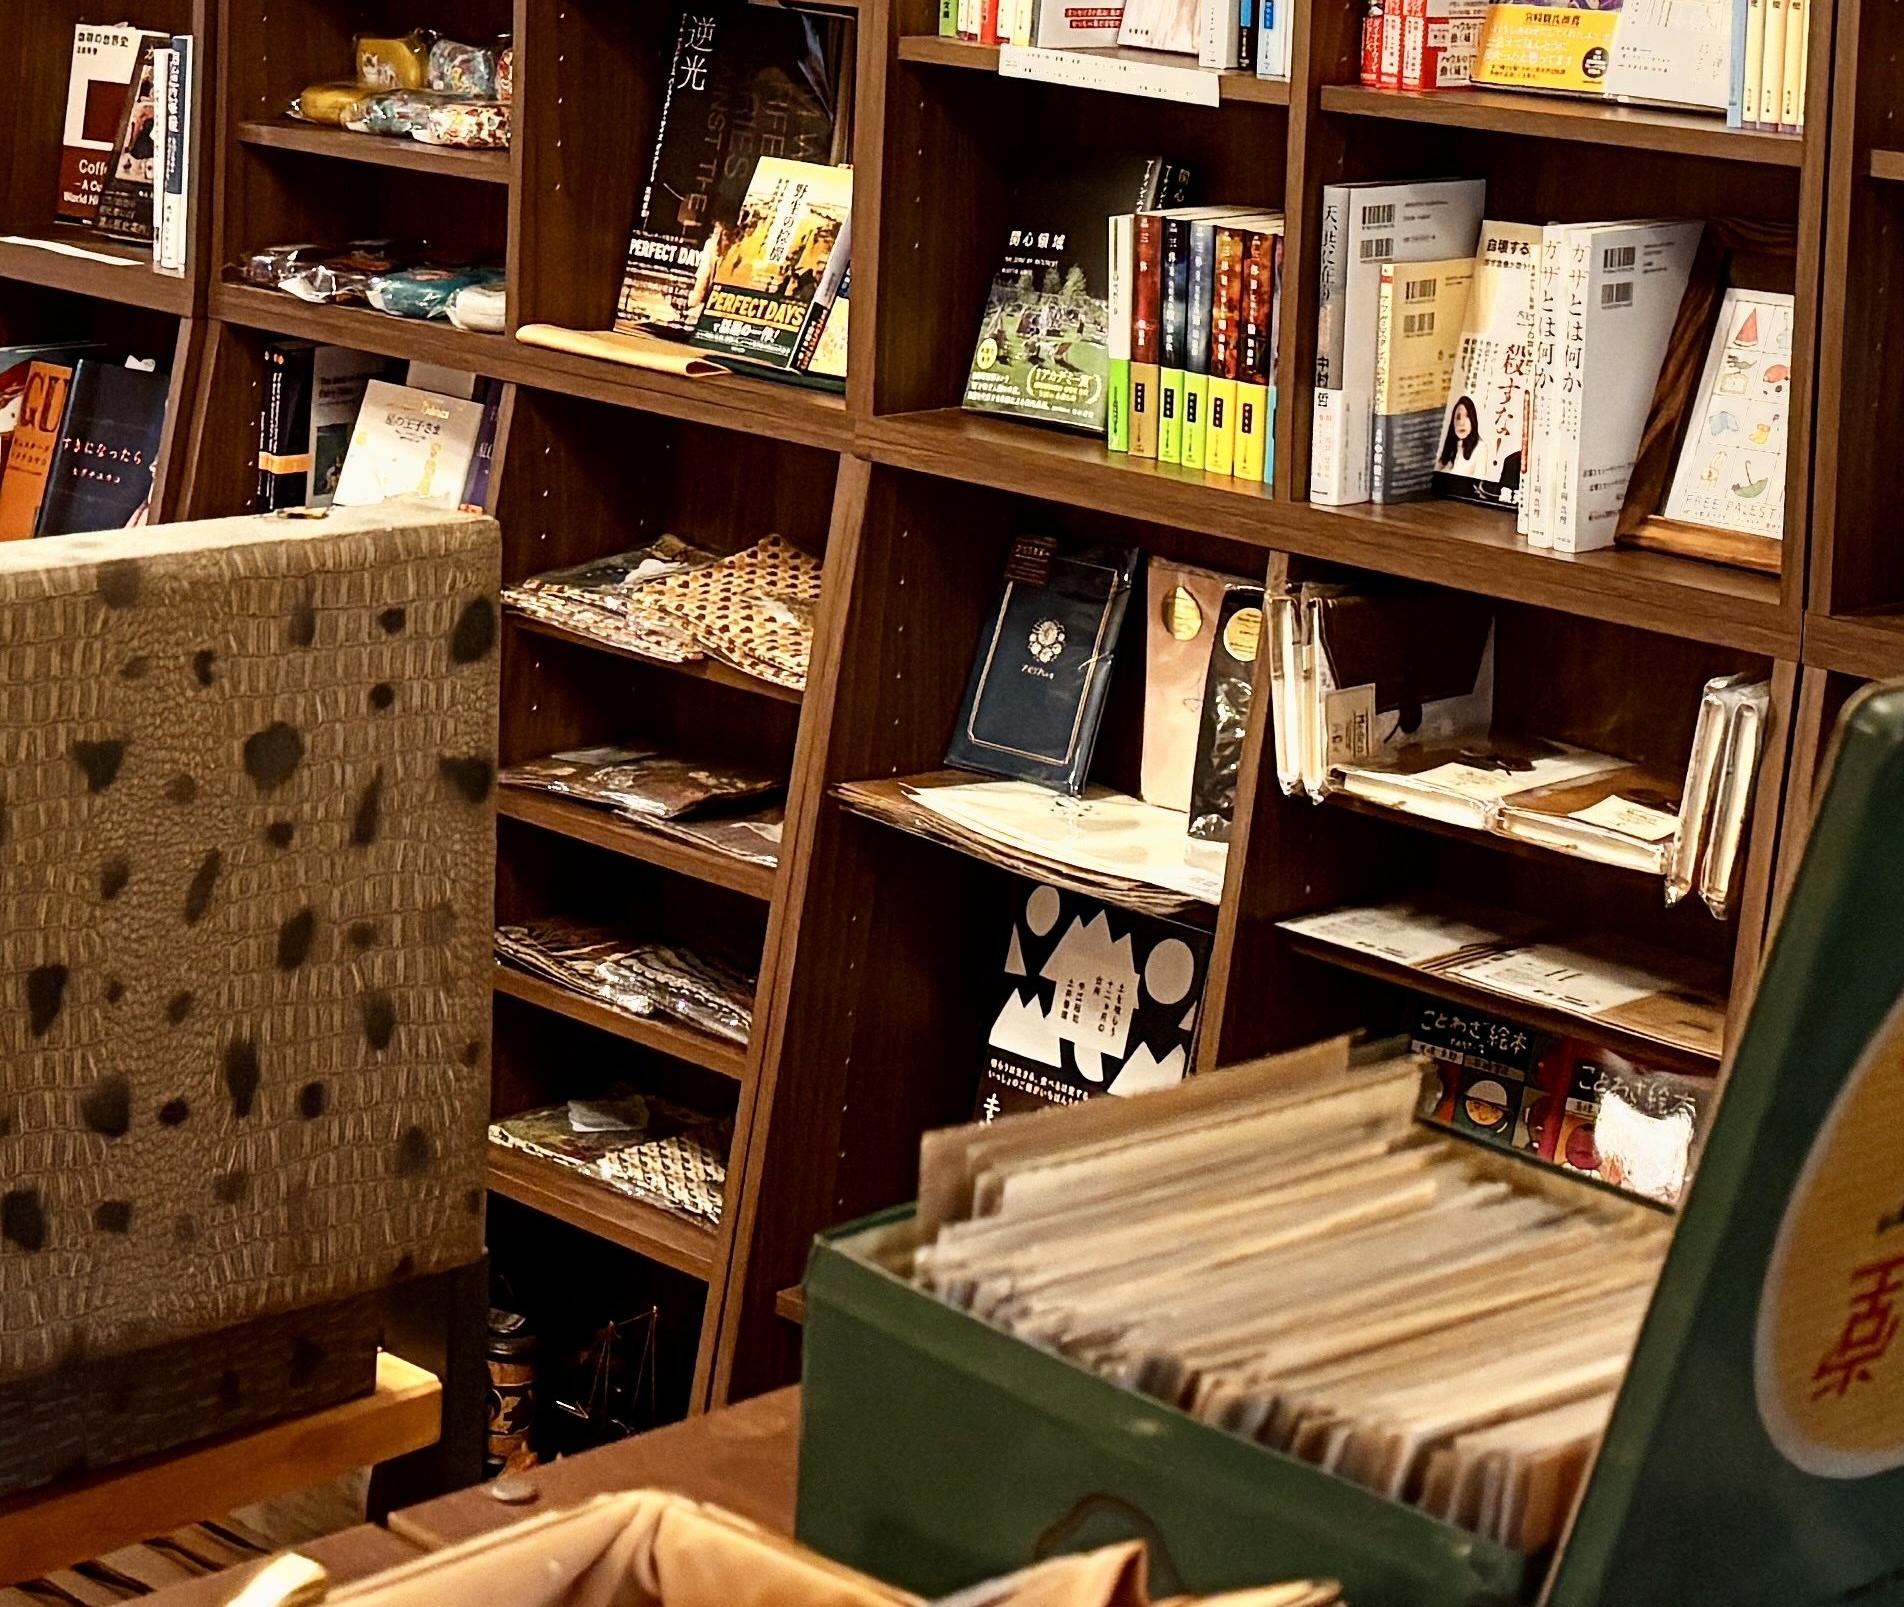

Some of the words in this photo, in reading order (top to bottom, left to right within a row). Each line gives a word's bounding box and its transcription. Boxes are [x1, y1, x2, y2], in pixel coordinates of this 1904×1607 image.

[677, 15, 717, 91] 逆光
[628, 238, 678, 264] PERFECT
[1008, 229, 1067, 251] 関心領域
[706, 290, 766, 320] PERFECT
[765, 301, 806, 327] DAYS
[1534, 238, 1563, 389] ガザとは何か
[1561, 239, 1592, 394] ガザとは何か
[1490, 342, 1527, 468] 殺すな!
[63, 437, 143, 465] すきになったら
[1420, 1009, 1527, 1054] ことわざ絵本
